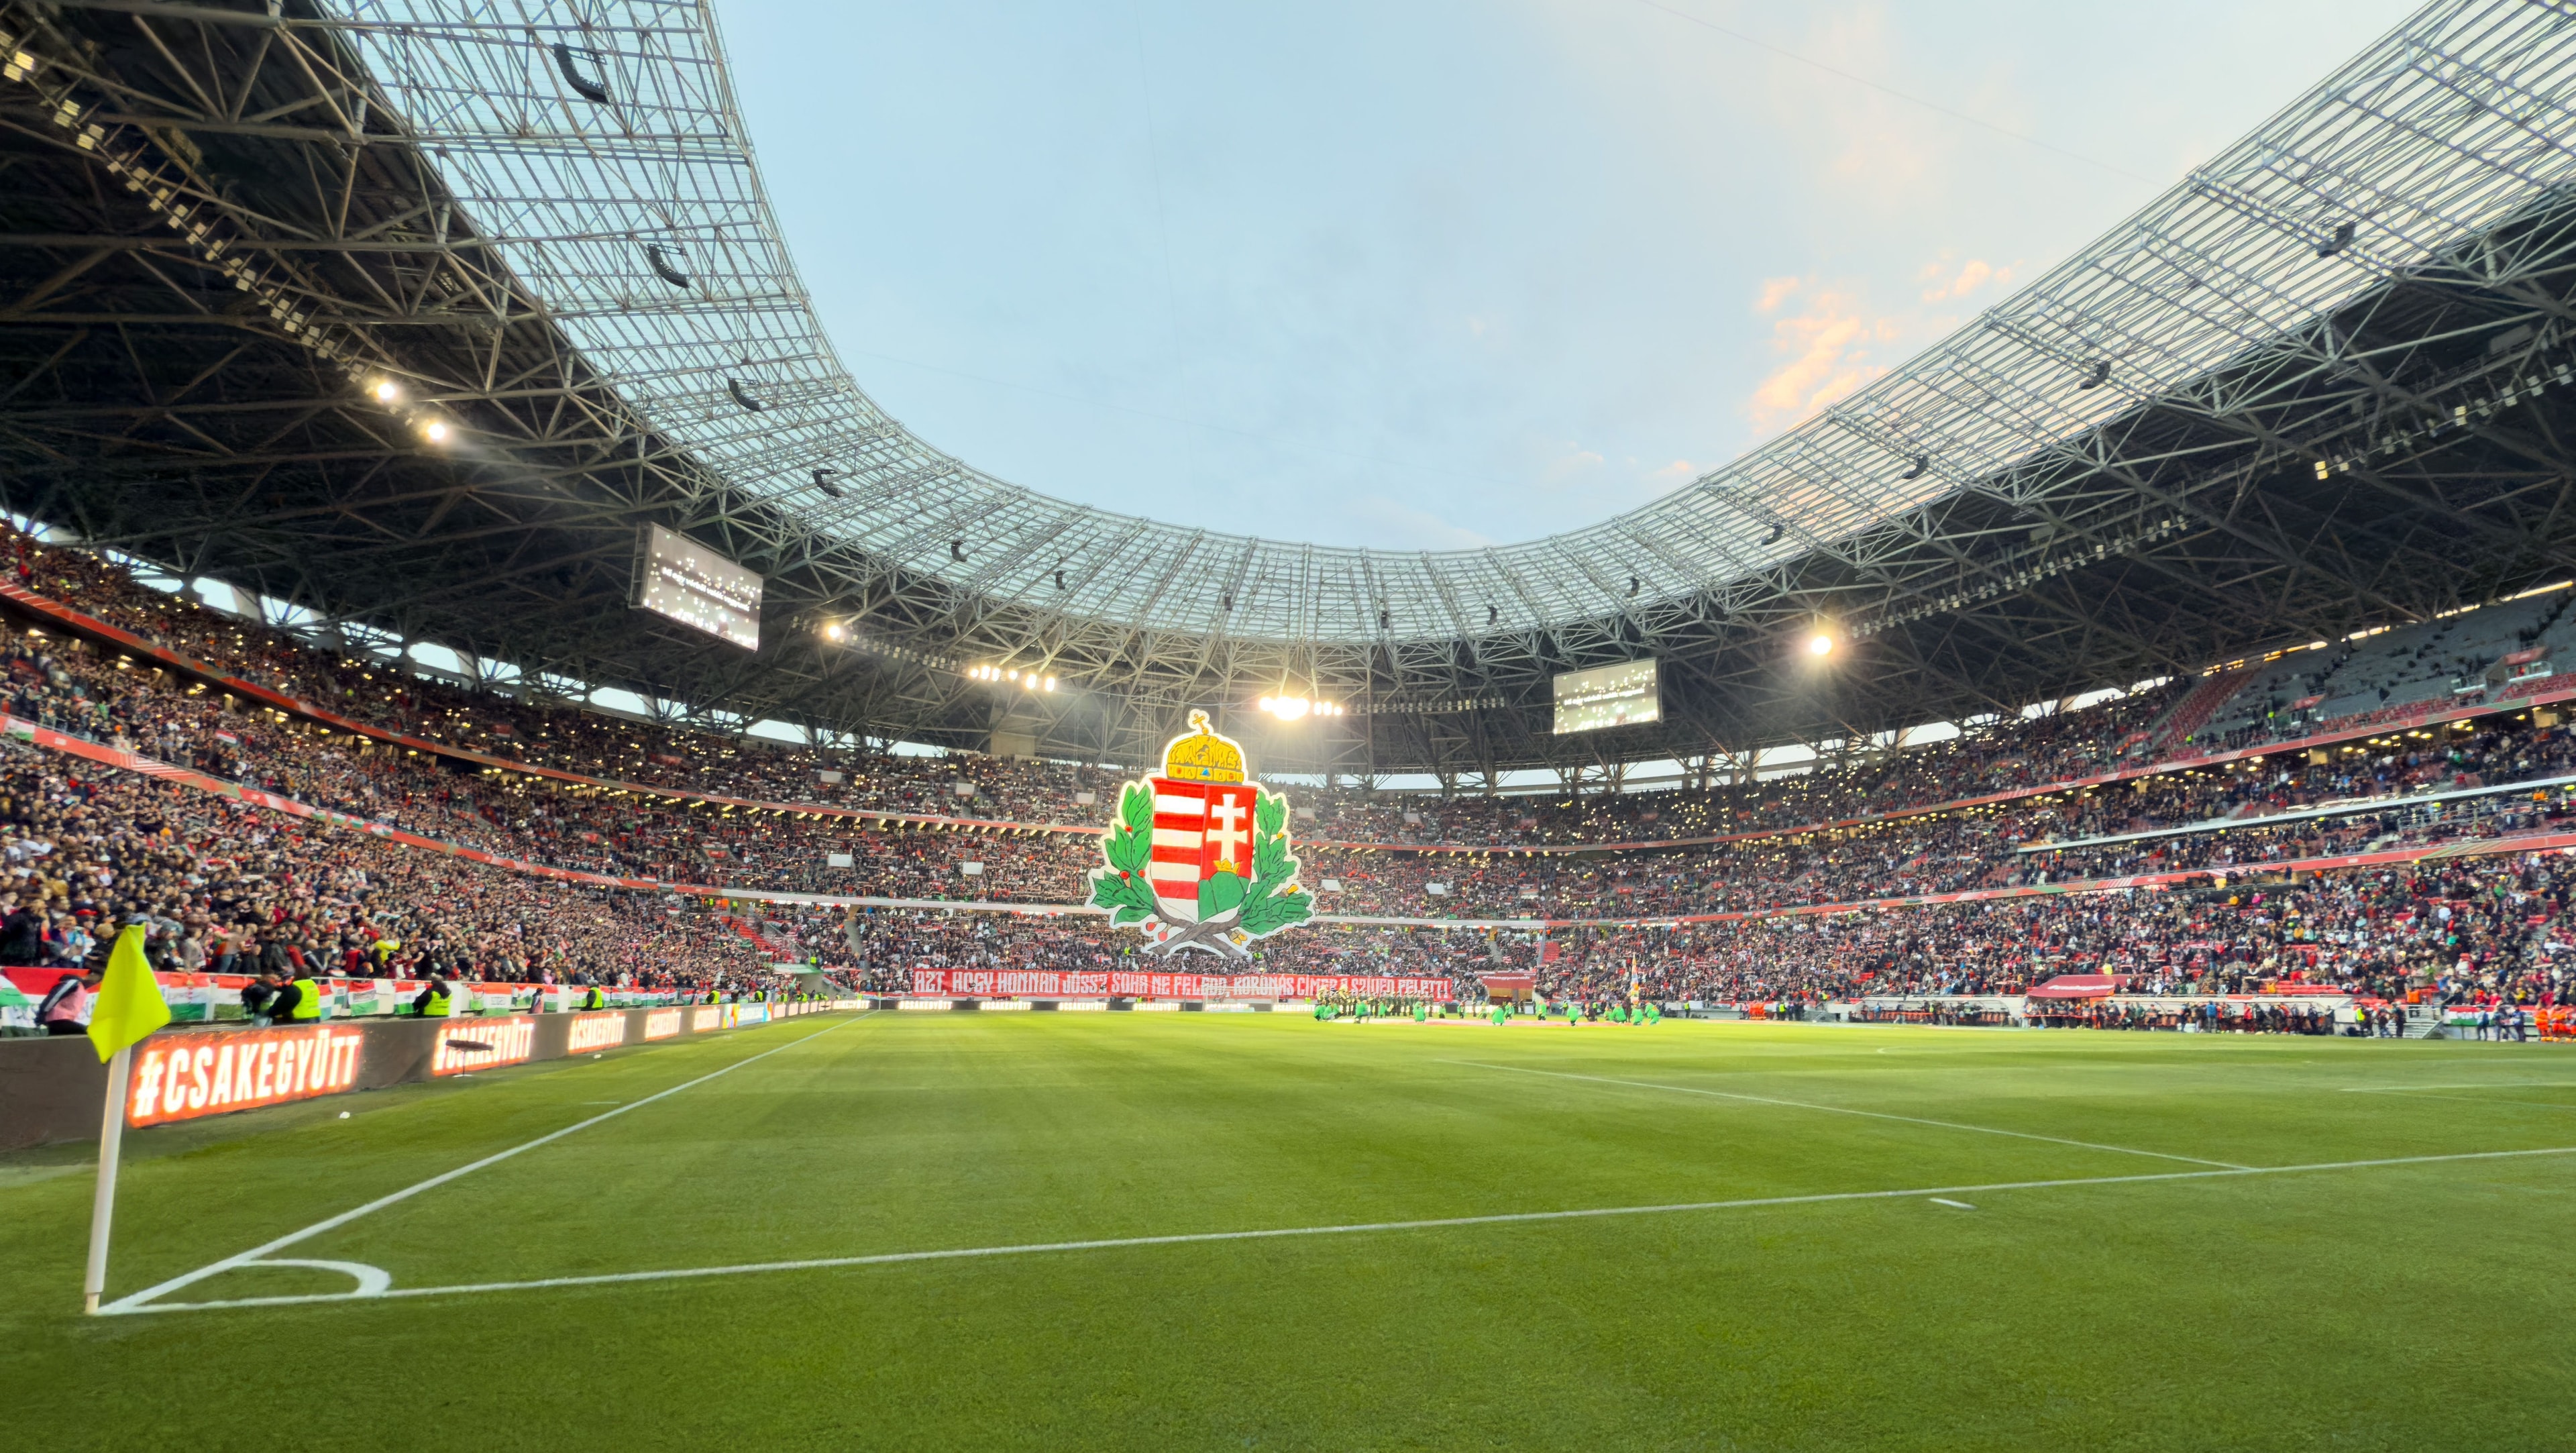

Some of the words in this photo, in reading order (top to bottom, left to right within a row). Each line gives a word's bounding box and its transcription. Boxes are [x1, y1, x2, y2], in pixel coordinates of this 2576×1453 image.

[953, 971, 994, 993] HOGY
[998, 971, 1059, 993] HONNAN
[1112, 973, 1148, 993] SOHA
[1152, 974, 1170, 995] NE
[133, 1029, 360, 1117] #CSAKEGYÜTT
